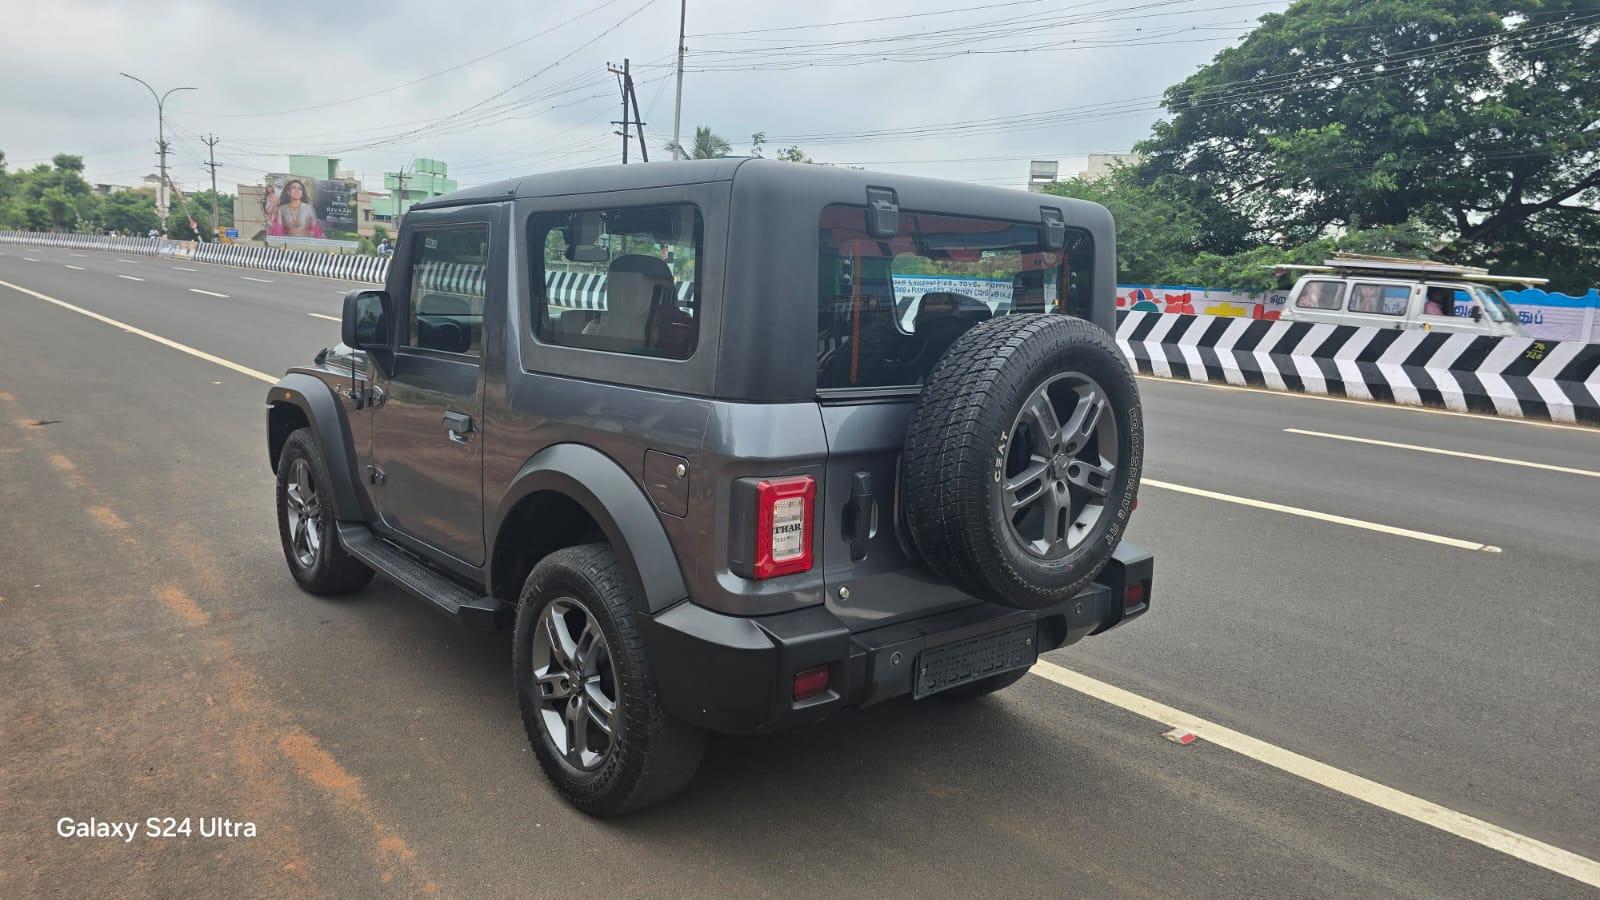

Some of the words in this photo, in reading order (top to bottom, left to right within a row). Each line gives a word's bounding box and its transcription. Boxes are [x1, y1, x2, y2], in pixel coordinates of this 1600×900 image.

[1534, 342, 1545, 351] 76
[994, 431, 1009, 483] CEAT
[774, 523, 803, 535] THAR
